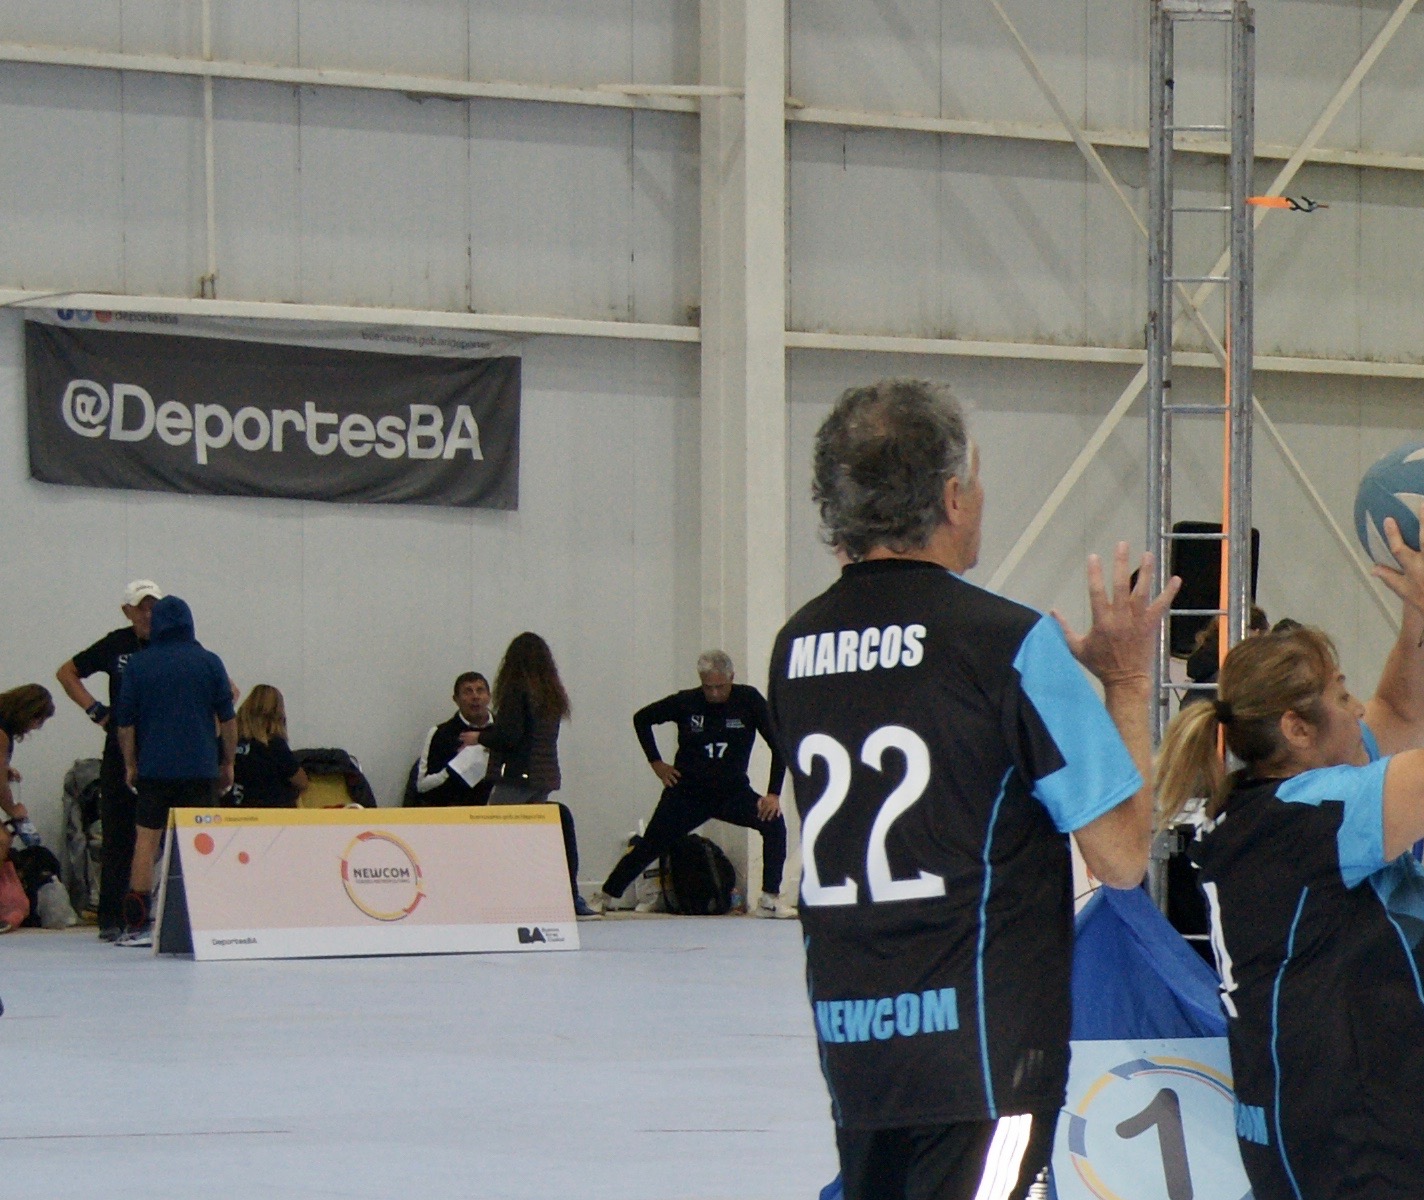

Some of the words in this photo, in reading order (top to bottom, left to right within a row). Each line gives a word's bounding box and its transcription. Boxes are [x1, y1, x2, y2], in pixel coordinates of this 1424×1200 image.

[62, 379, 484, 464] @DeportesBA
[788, 624, 927, 679] MARCOS
[705, 742, 728, 758] 17
[798, 725, 946, 907] 22
[354, 868, 410, 878] NEWCOM
[518, 927, 546, 944] BA
[816, 987, 959, 1043] NEWCOM
